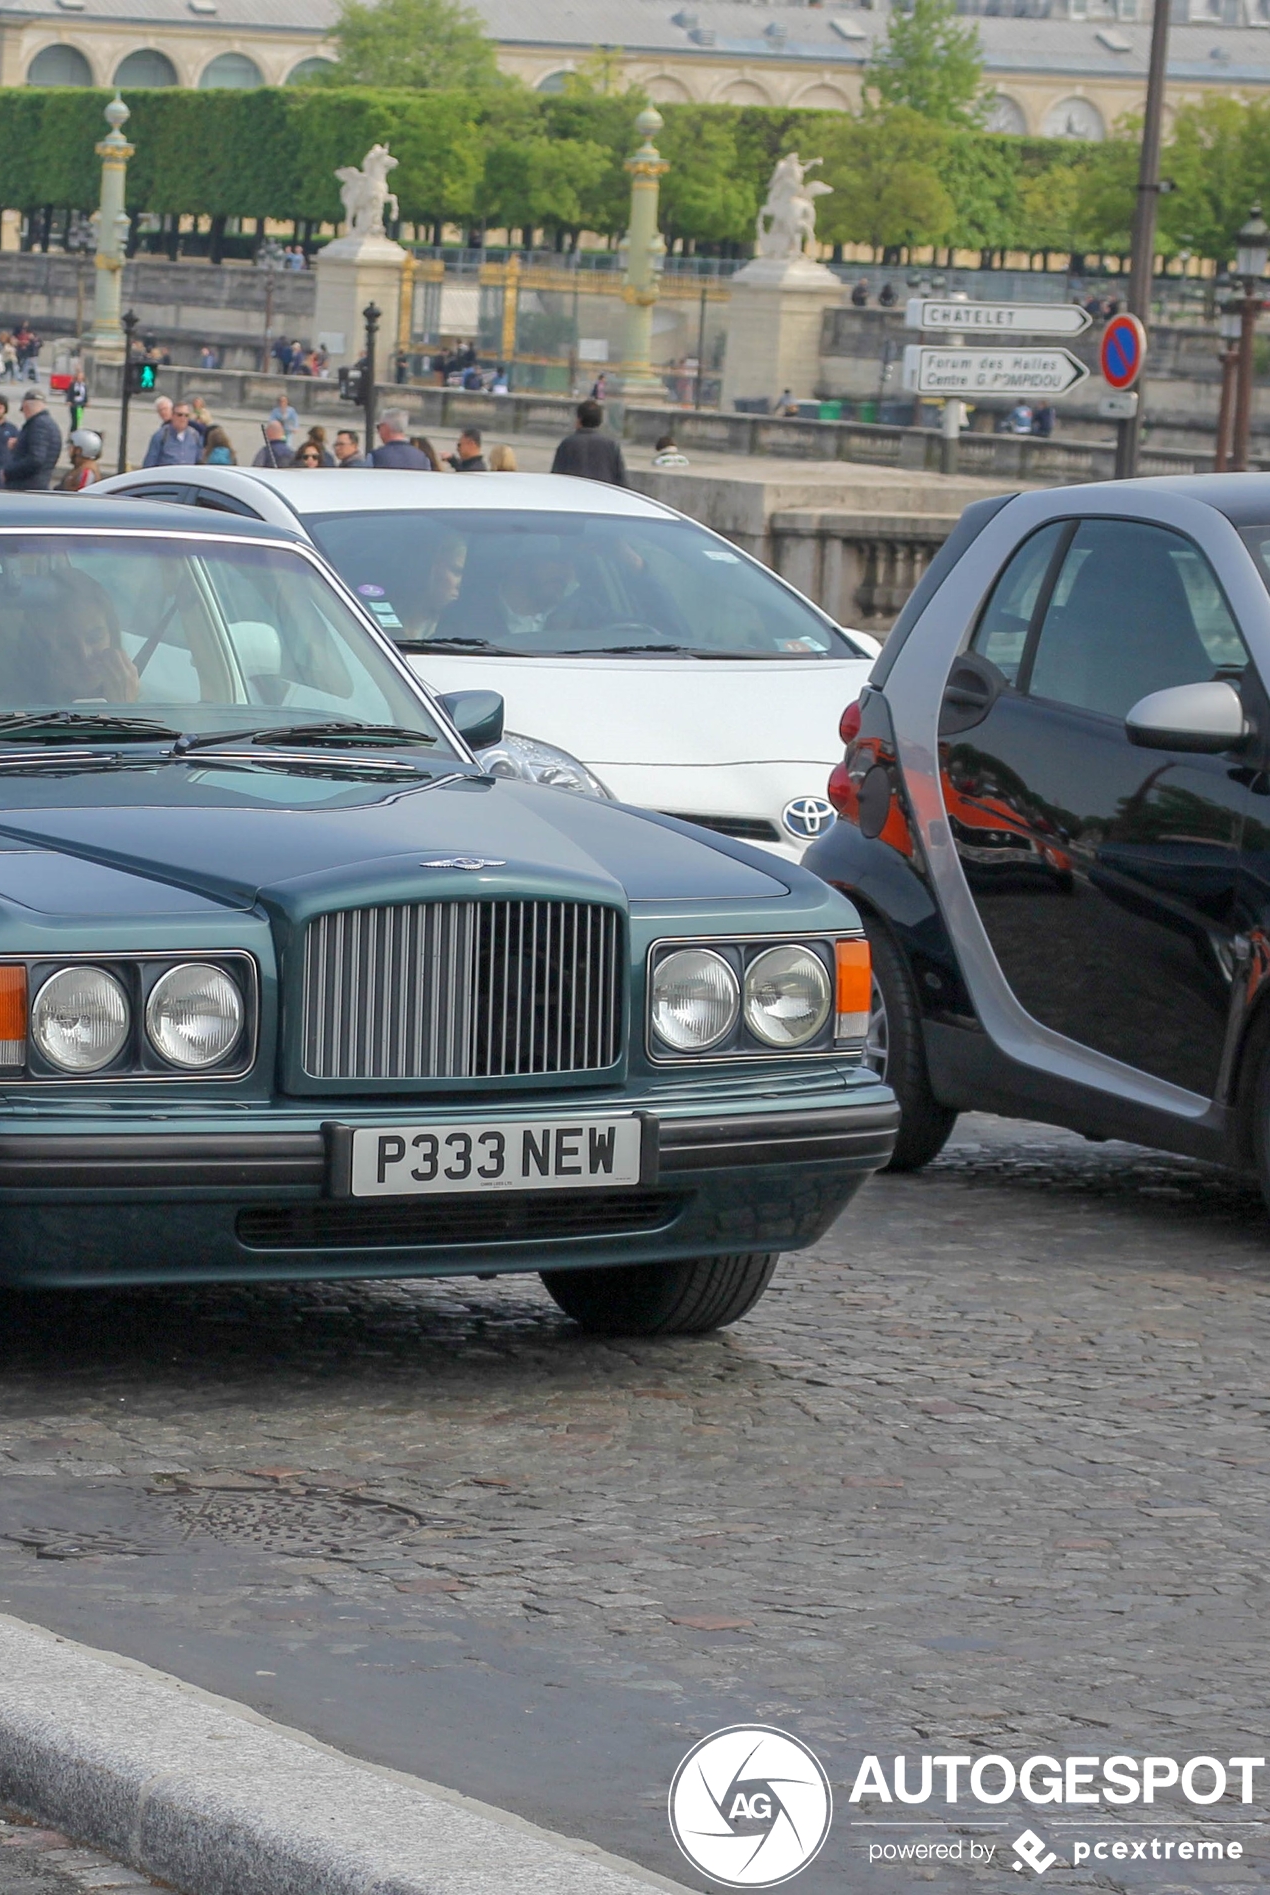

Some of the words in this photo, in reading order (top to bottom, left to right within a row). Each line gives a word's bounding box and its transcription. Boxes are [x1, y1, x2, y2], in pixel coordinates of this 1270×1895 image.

[931, 308, 1015, 326] CHATELET
[929, 355, 972, 370] Forum
[979, 355, 1003, 370] des
[1013, 357, 1057, 371] Halles
[927, 369, 968, 386] Centre
[378, 1131, 505, 1183] P333
[522, 1126, 616, 1177] NEW
